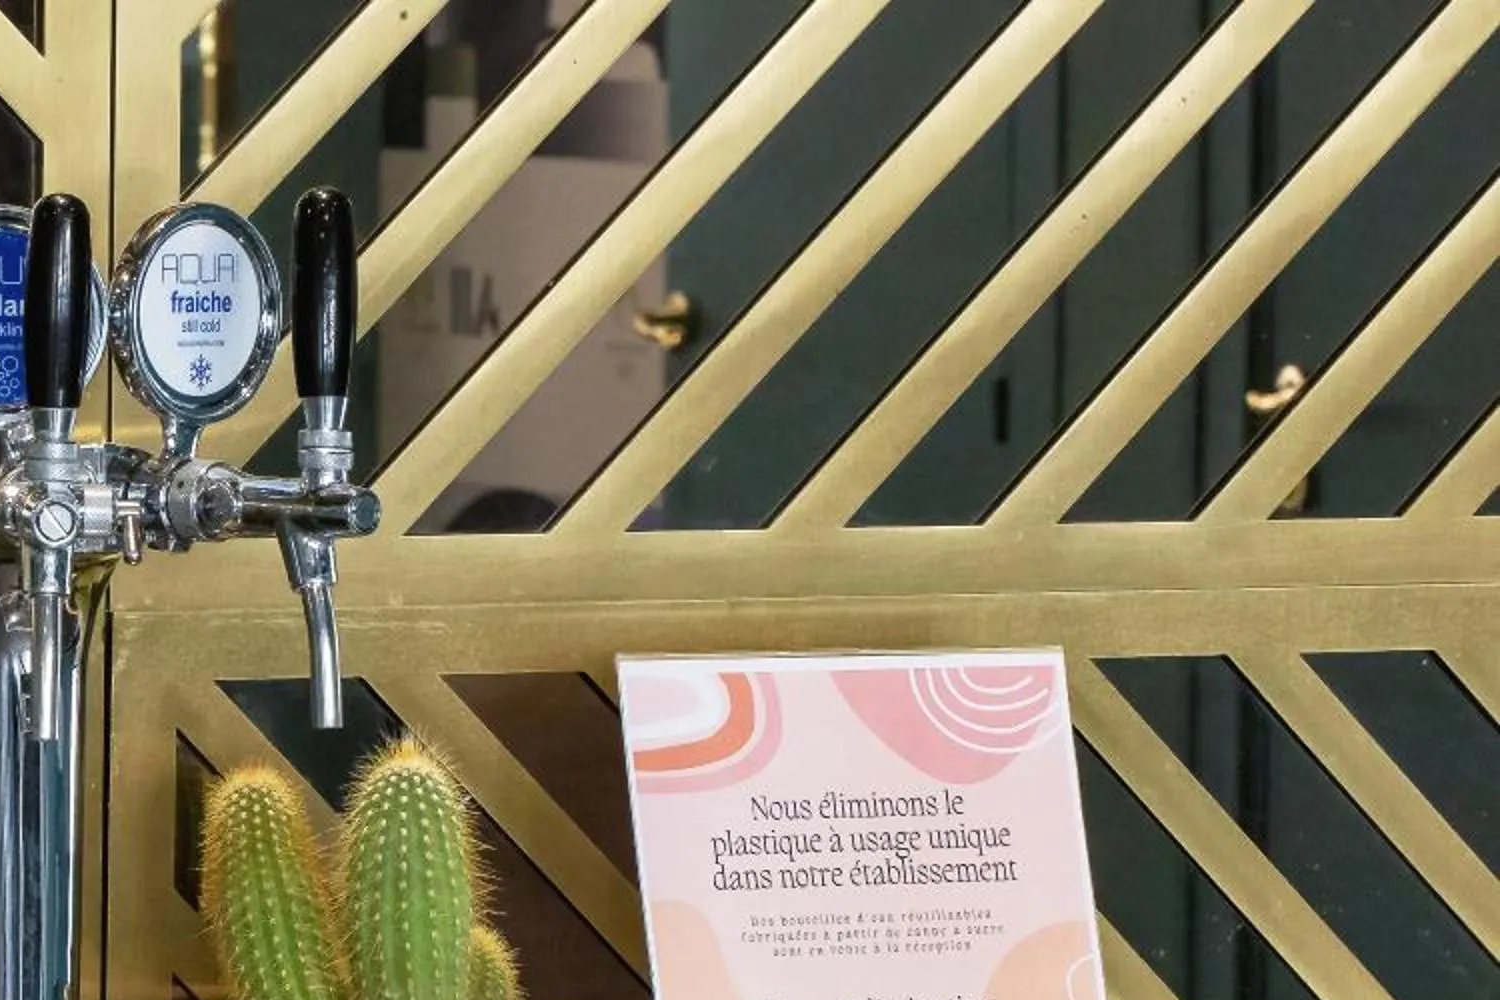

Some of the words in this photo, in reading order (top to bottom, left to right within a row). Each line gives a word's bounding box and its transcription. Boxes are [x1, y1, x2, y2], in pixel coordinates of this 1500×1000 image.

[162, 254, 235, 284] AQUA
[200, 318, 221, 333] cold
[751, 796, 811, 820] Nous
[819, 792, 938, 818] éliminons
[945, 789, 964, 815] le
[711, 830, 822, 864] plastique
[829, 826, 844, 852] à
[850, 830, 921, 860] usage
[928, 823, 1011, 856] unique
[713, 864, 773, 890] dans
[780, 865, 844, 888] notre
[850, 858, 1019, 886] établissement
